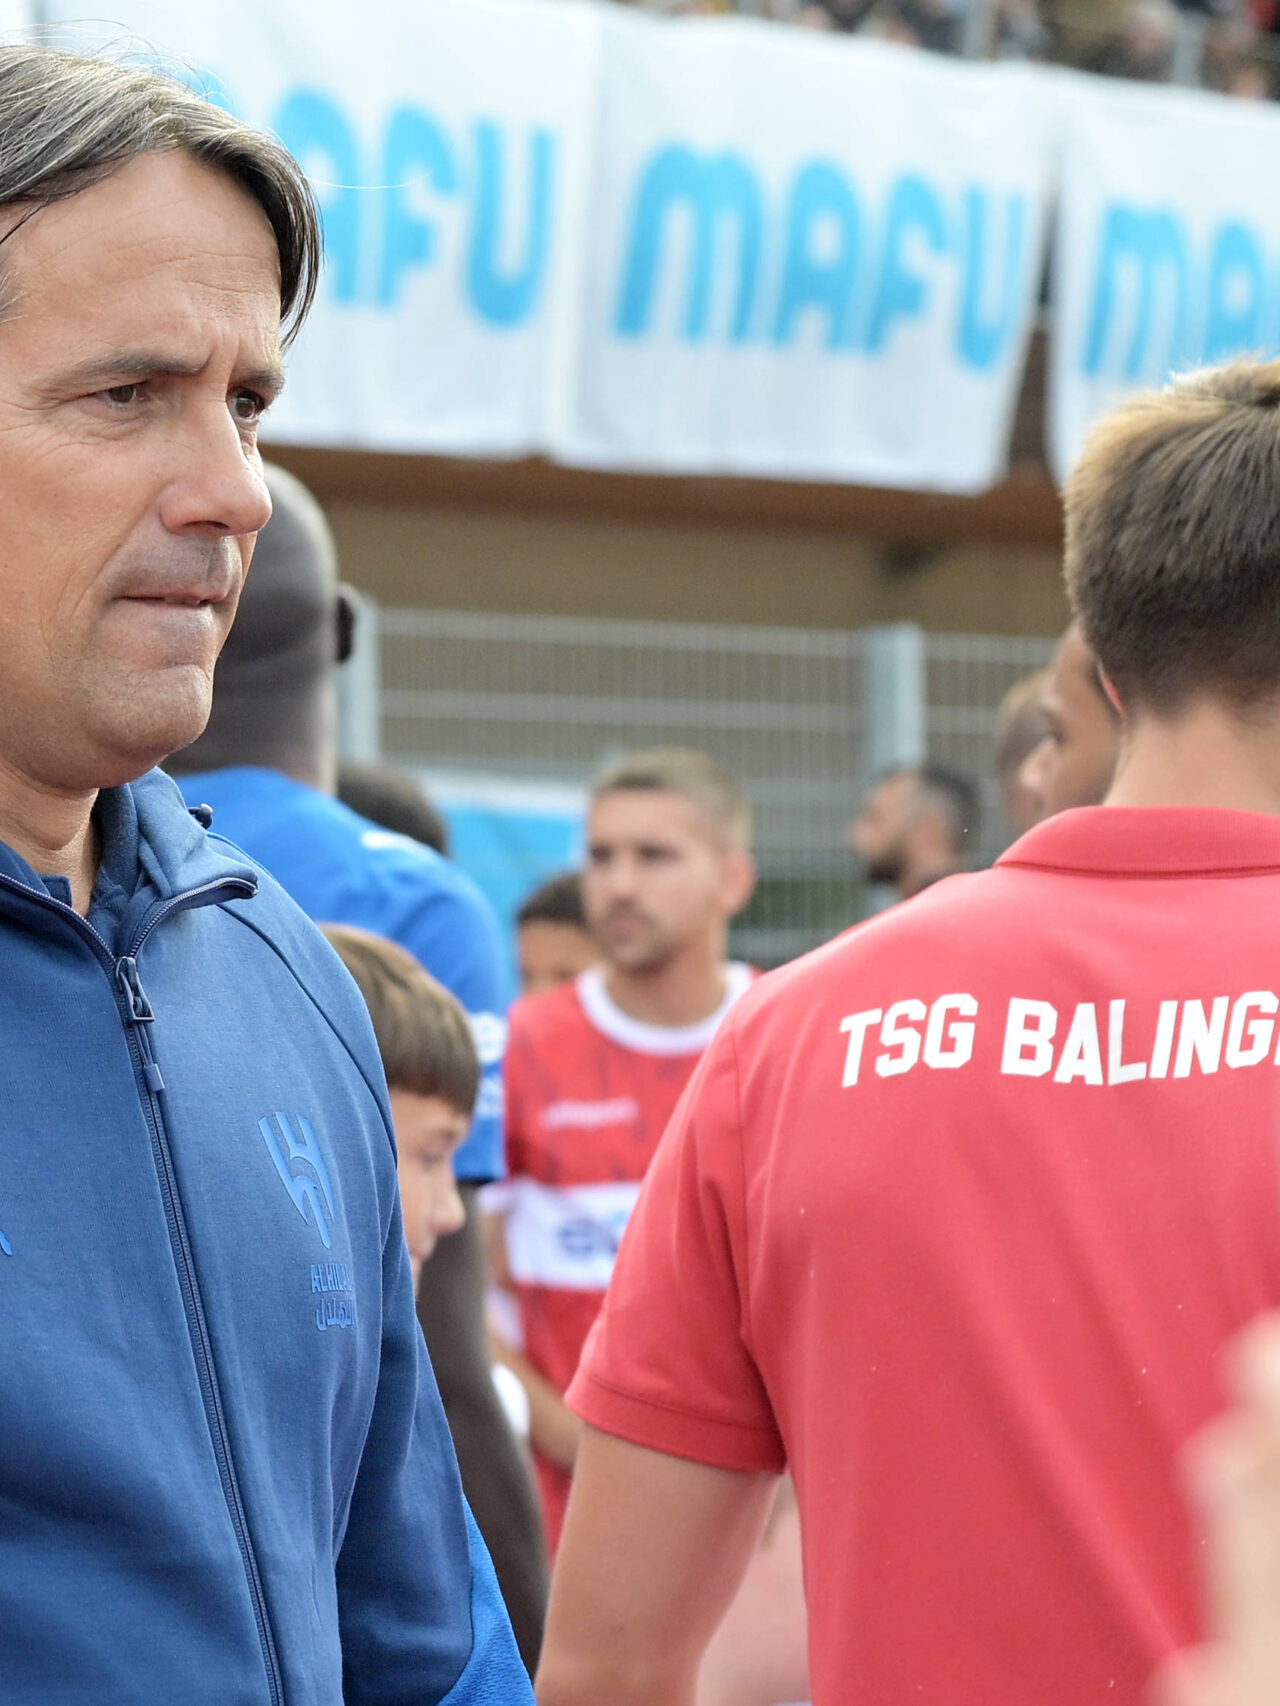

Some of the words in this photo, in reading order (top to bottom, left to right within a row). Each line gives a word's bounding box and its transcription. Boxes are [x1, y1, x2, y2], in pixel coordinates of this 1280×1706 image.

[170, 62, 556, 330] AFU
[612, 142, 1026, 375] MAFU
[1080, 203, 1280, 382] MA
[840, 993, 978, 1088] TSG
[1001, 990, 1280, 1086] BALING
